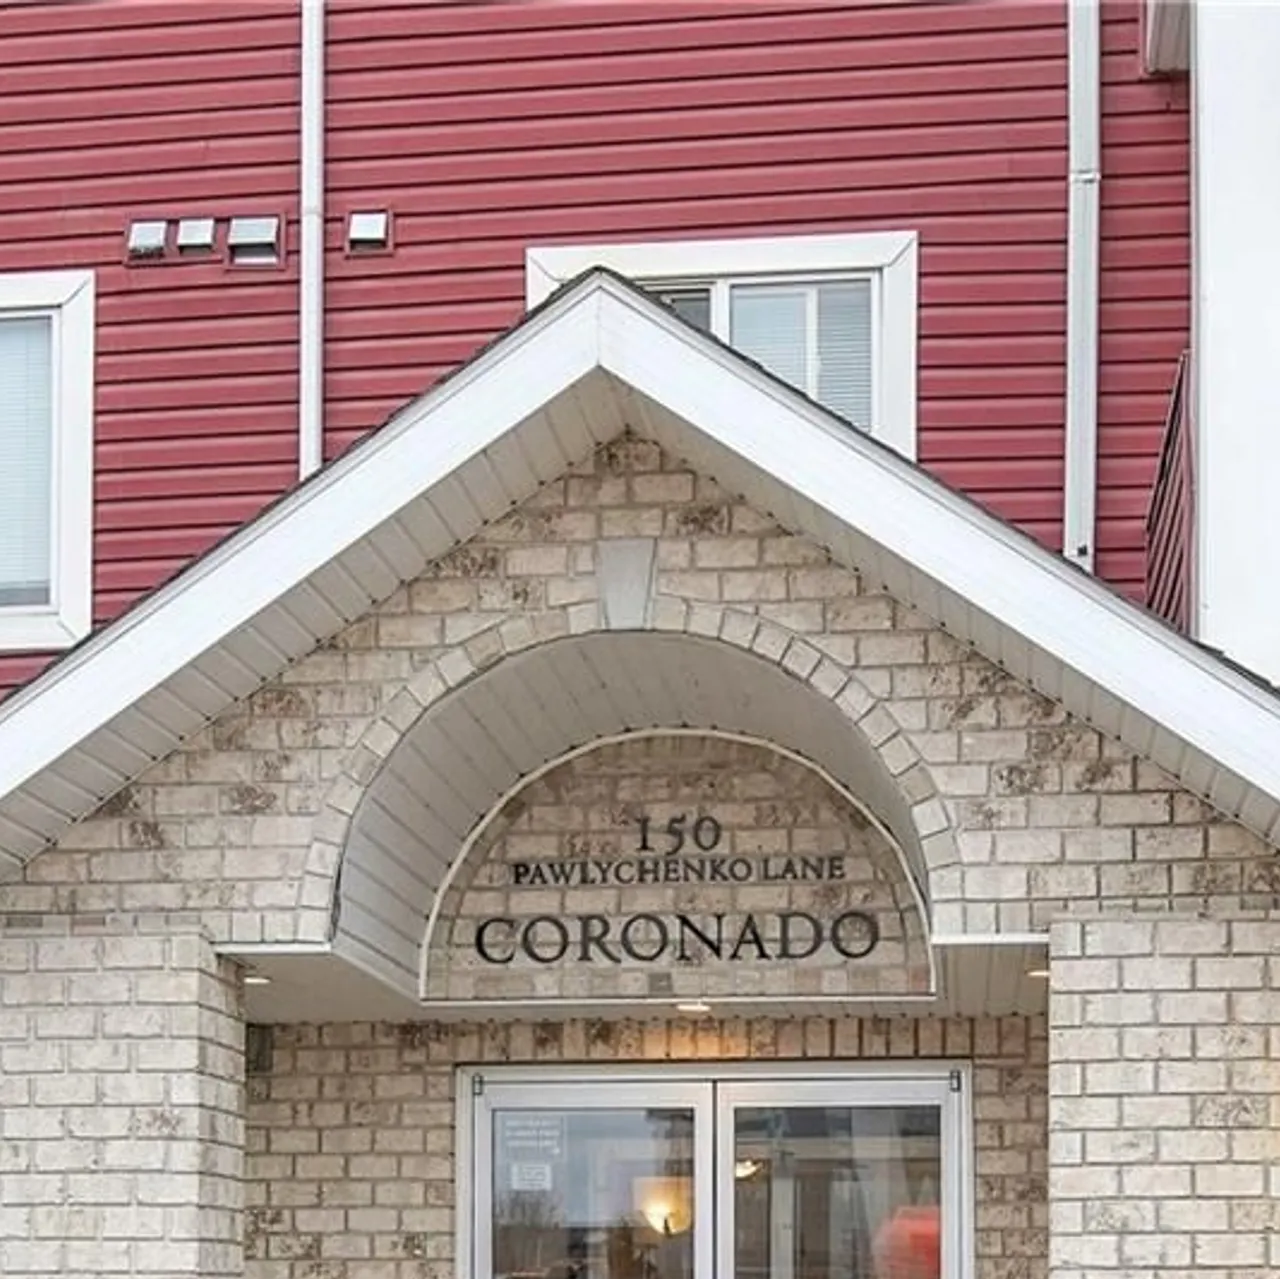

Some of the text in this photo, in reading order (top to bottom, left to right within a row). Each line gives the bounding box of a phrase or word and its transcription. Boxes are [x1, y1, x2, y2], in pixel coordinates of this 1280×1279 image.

[635, 816, 722, 857] 150
[512, 856, 847, 885] PAWLYCHENKO LANE
[474, 911, 880, 964] CORONADO
